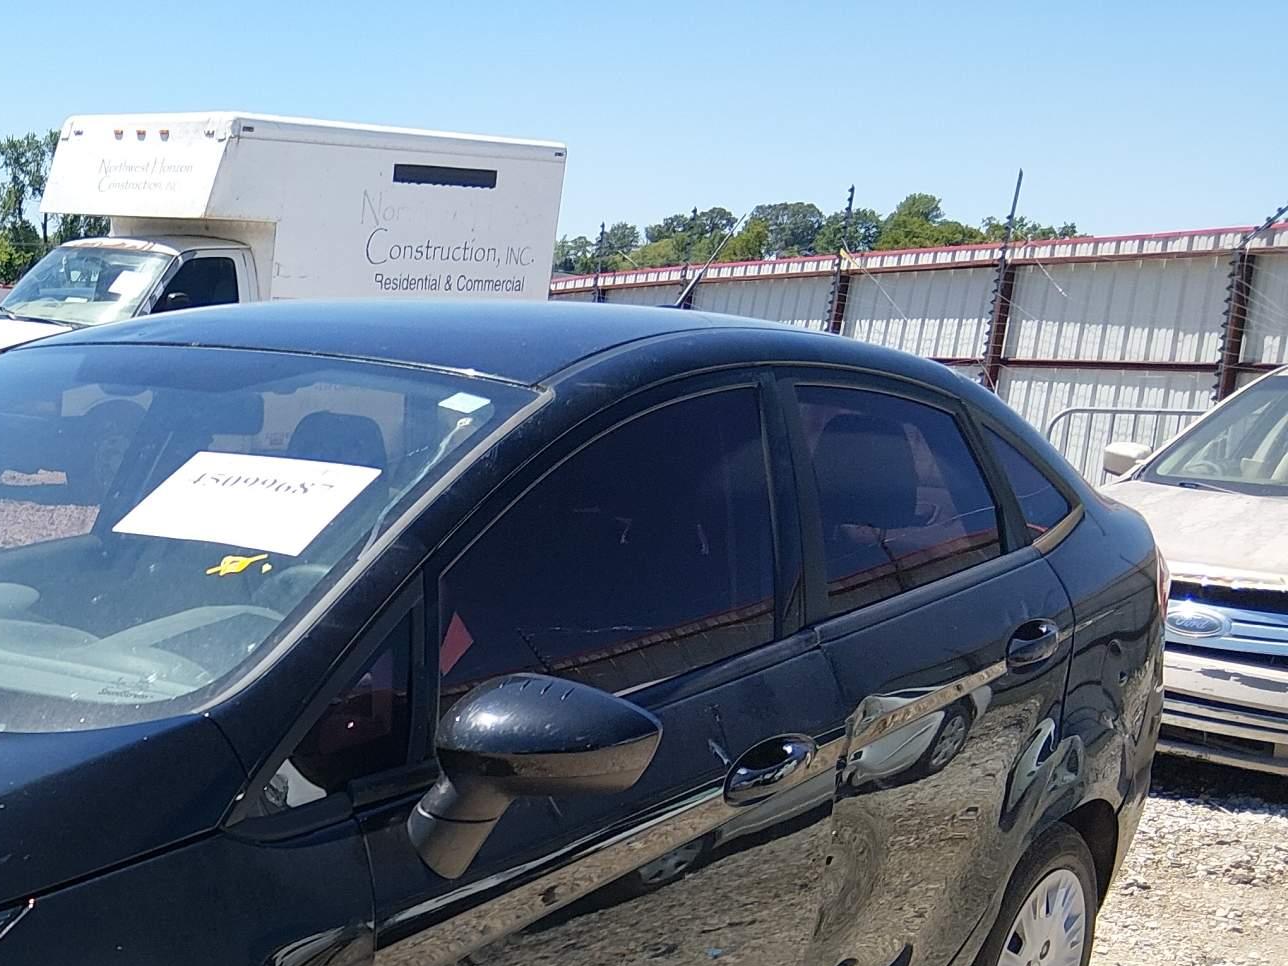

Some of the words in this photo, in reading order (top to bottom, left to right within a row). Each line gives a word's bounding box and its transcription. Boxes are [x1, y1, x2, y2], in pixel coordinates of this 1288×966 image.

[365, 227, 501, 268] Construction,
[505, 245, 535, 266] INC.
[374, 273, 441, 292] Residential
[444, 274, 453, 292] &
[456, 274, 525, 292] Commercial
[1175, 614, 1208, 631] Ford
